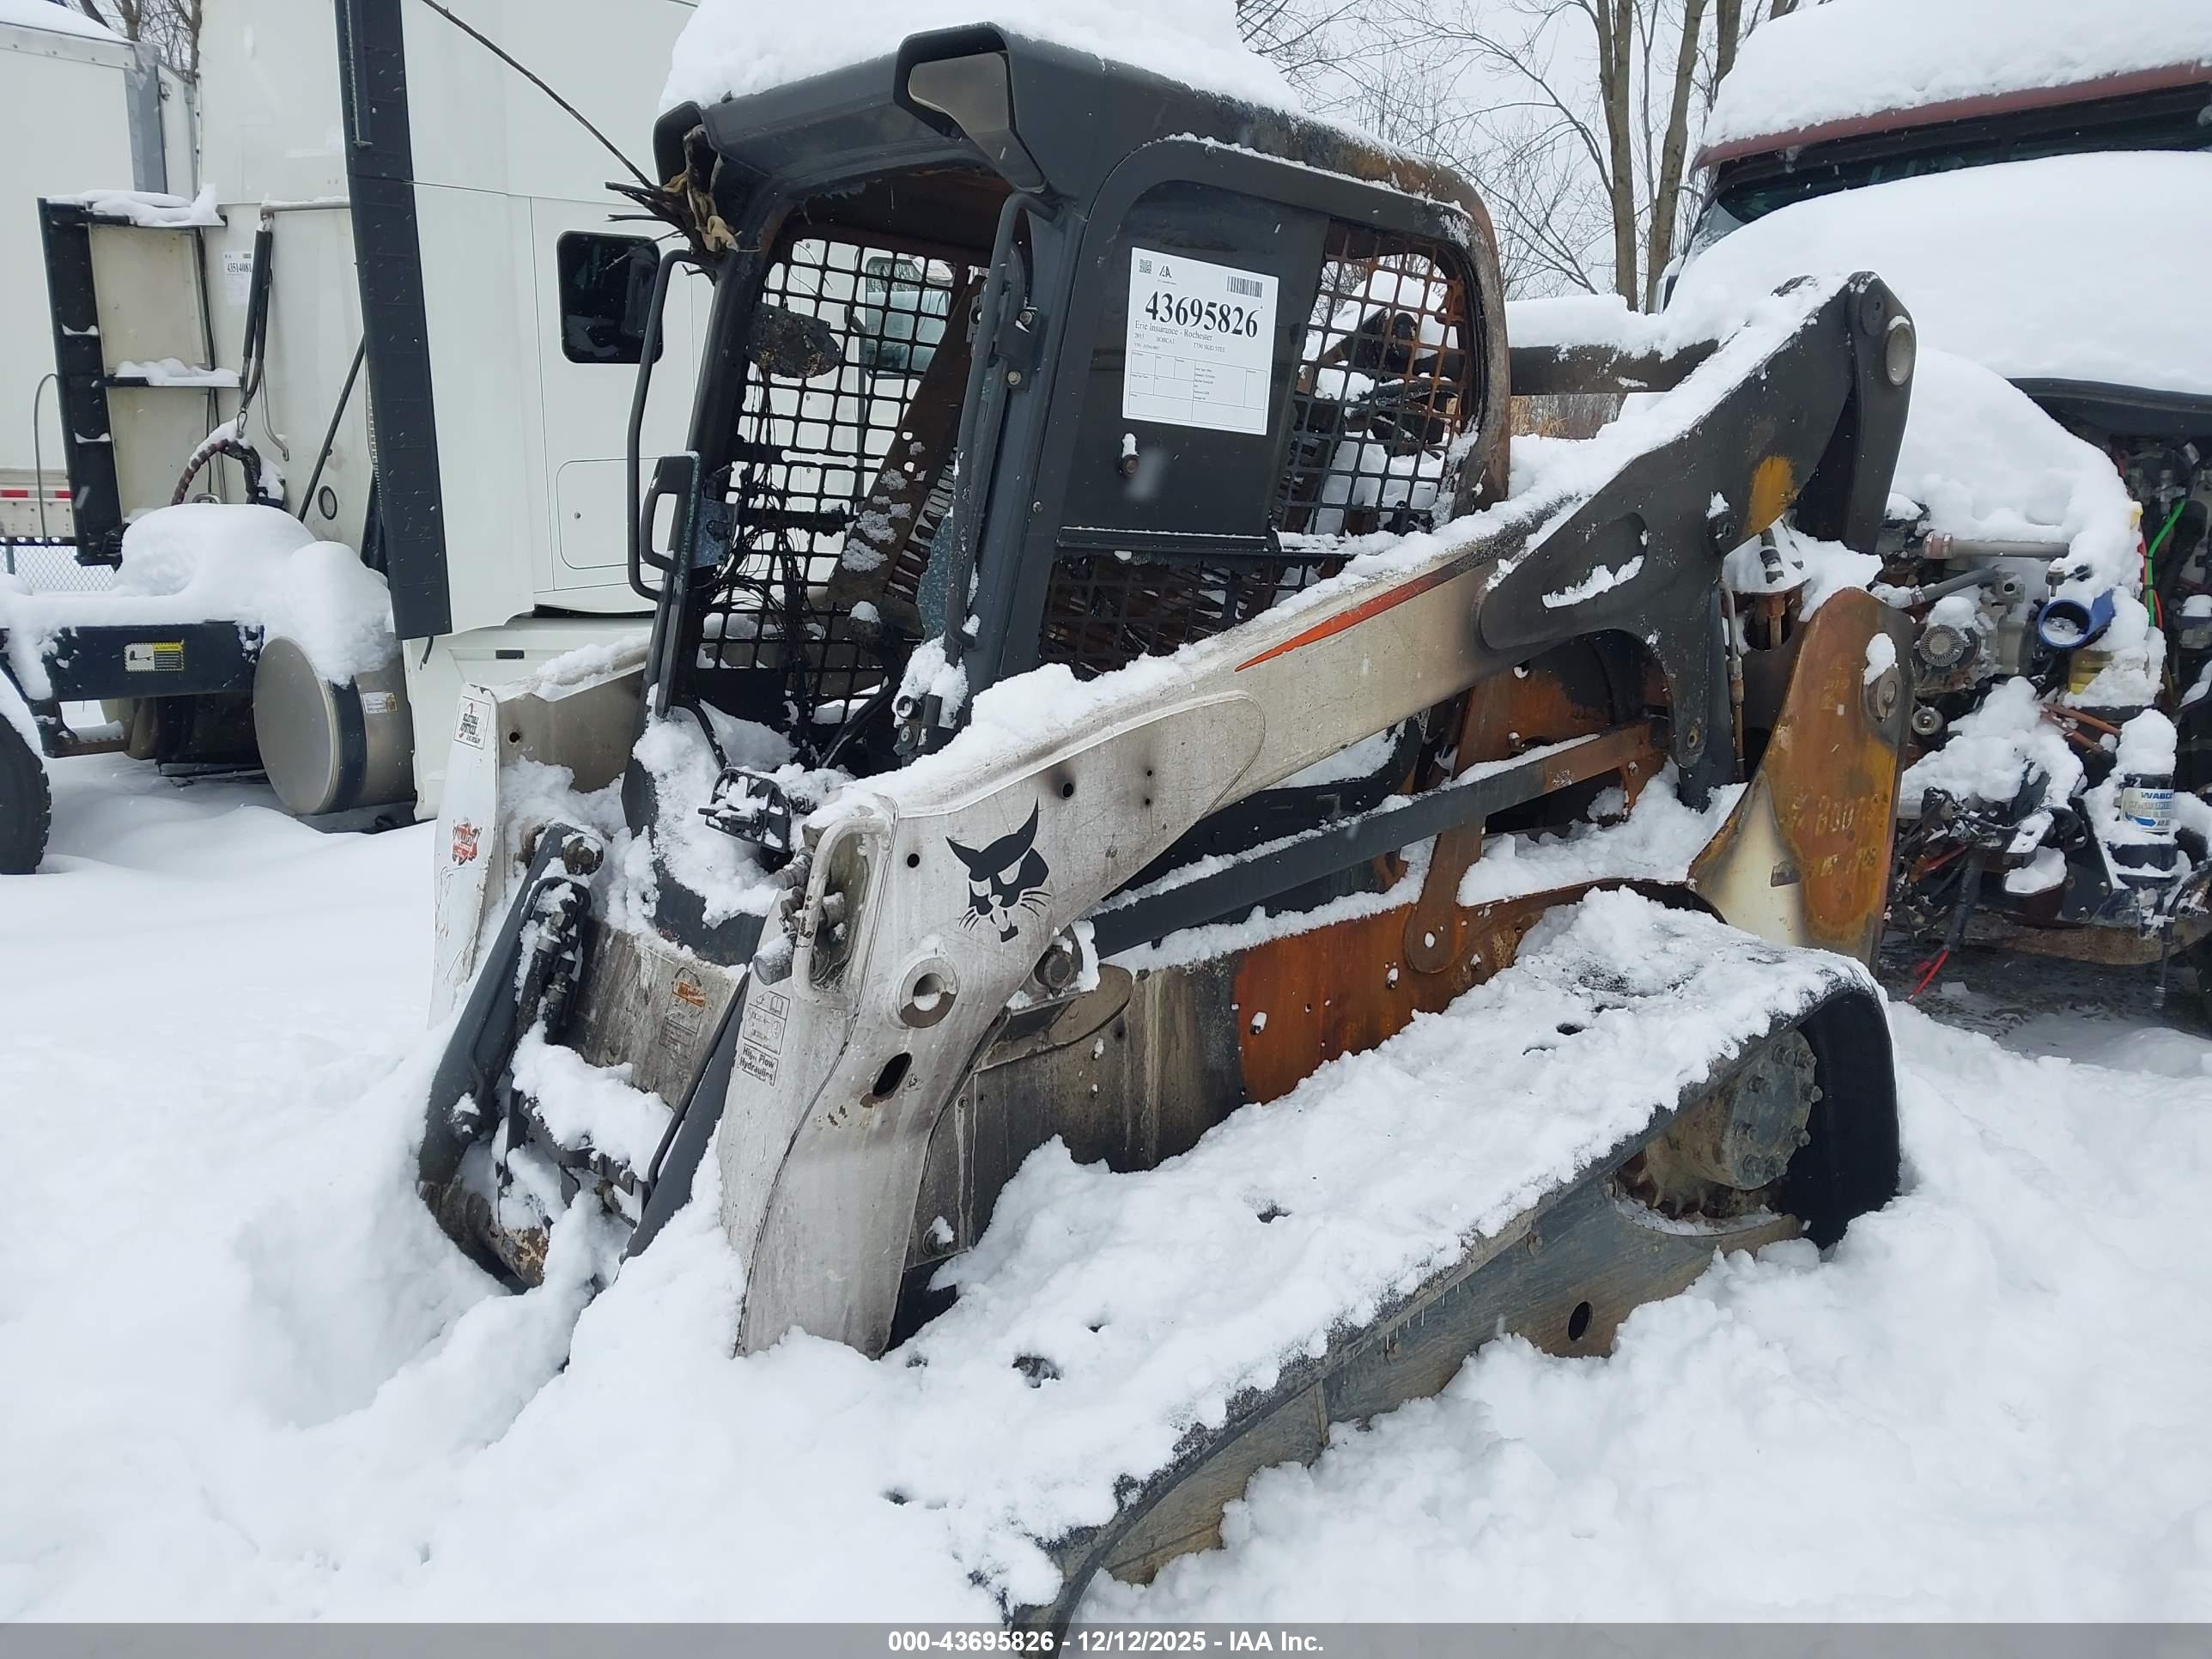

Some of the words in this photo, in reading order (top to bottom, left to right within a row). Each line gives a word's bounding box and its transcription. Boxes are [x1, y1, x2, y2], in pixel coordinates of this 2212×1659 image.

[1145, 290, 1260, 337] 43695826
[1134, 319, 1148, 331] Erie
[1149, 322, 1179, 336] Insurance
[1183, 329, 1213, 341] Rochester
[739, 1056, 774, 1081] Hydraulics
[758, 1054, 775, 1069] Flow
